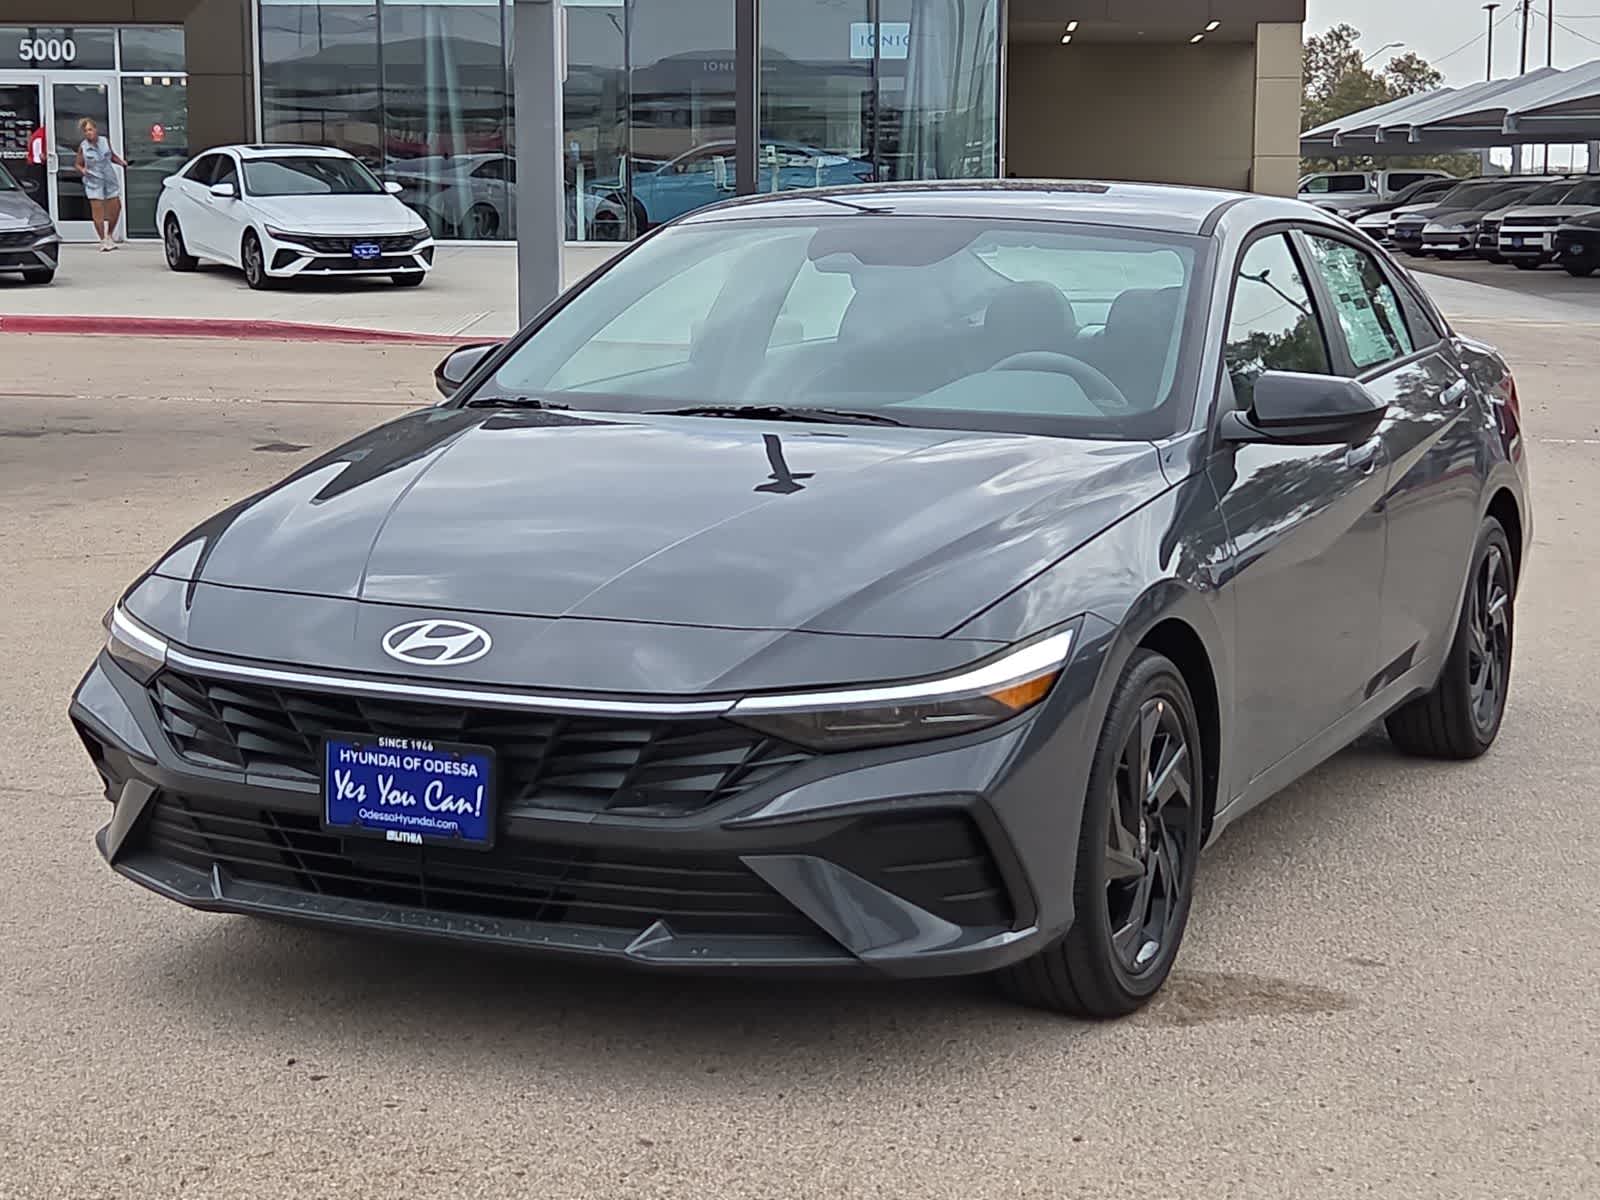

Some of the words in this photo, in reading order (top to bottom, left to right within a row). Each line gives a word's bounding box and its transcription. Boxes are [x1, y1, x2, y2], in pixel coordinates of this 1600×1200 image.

[19, 39, 76, 61] 5000
[378, 737, 408, 749] SINCE
[411, 740, 434, 751] 1946
[340, 749, 400, 768] HYUNDAI
[403, 757, 421, 770] OF
[423, 759, 478, 777] ODESSA
[334, 769, 367, 802] Yes
[377, 774, 416, 807] You
[424, 780, 484, 817] Can!
[358, 808, 458, 831] OdessaHyundai.com
